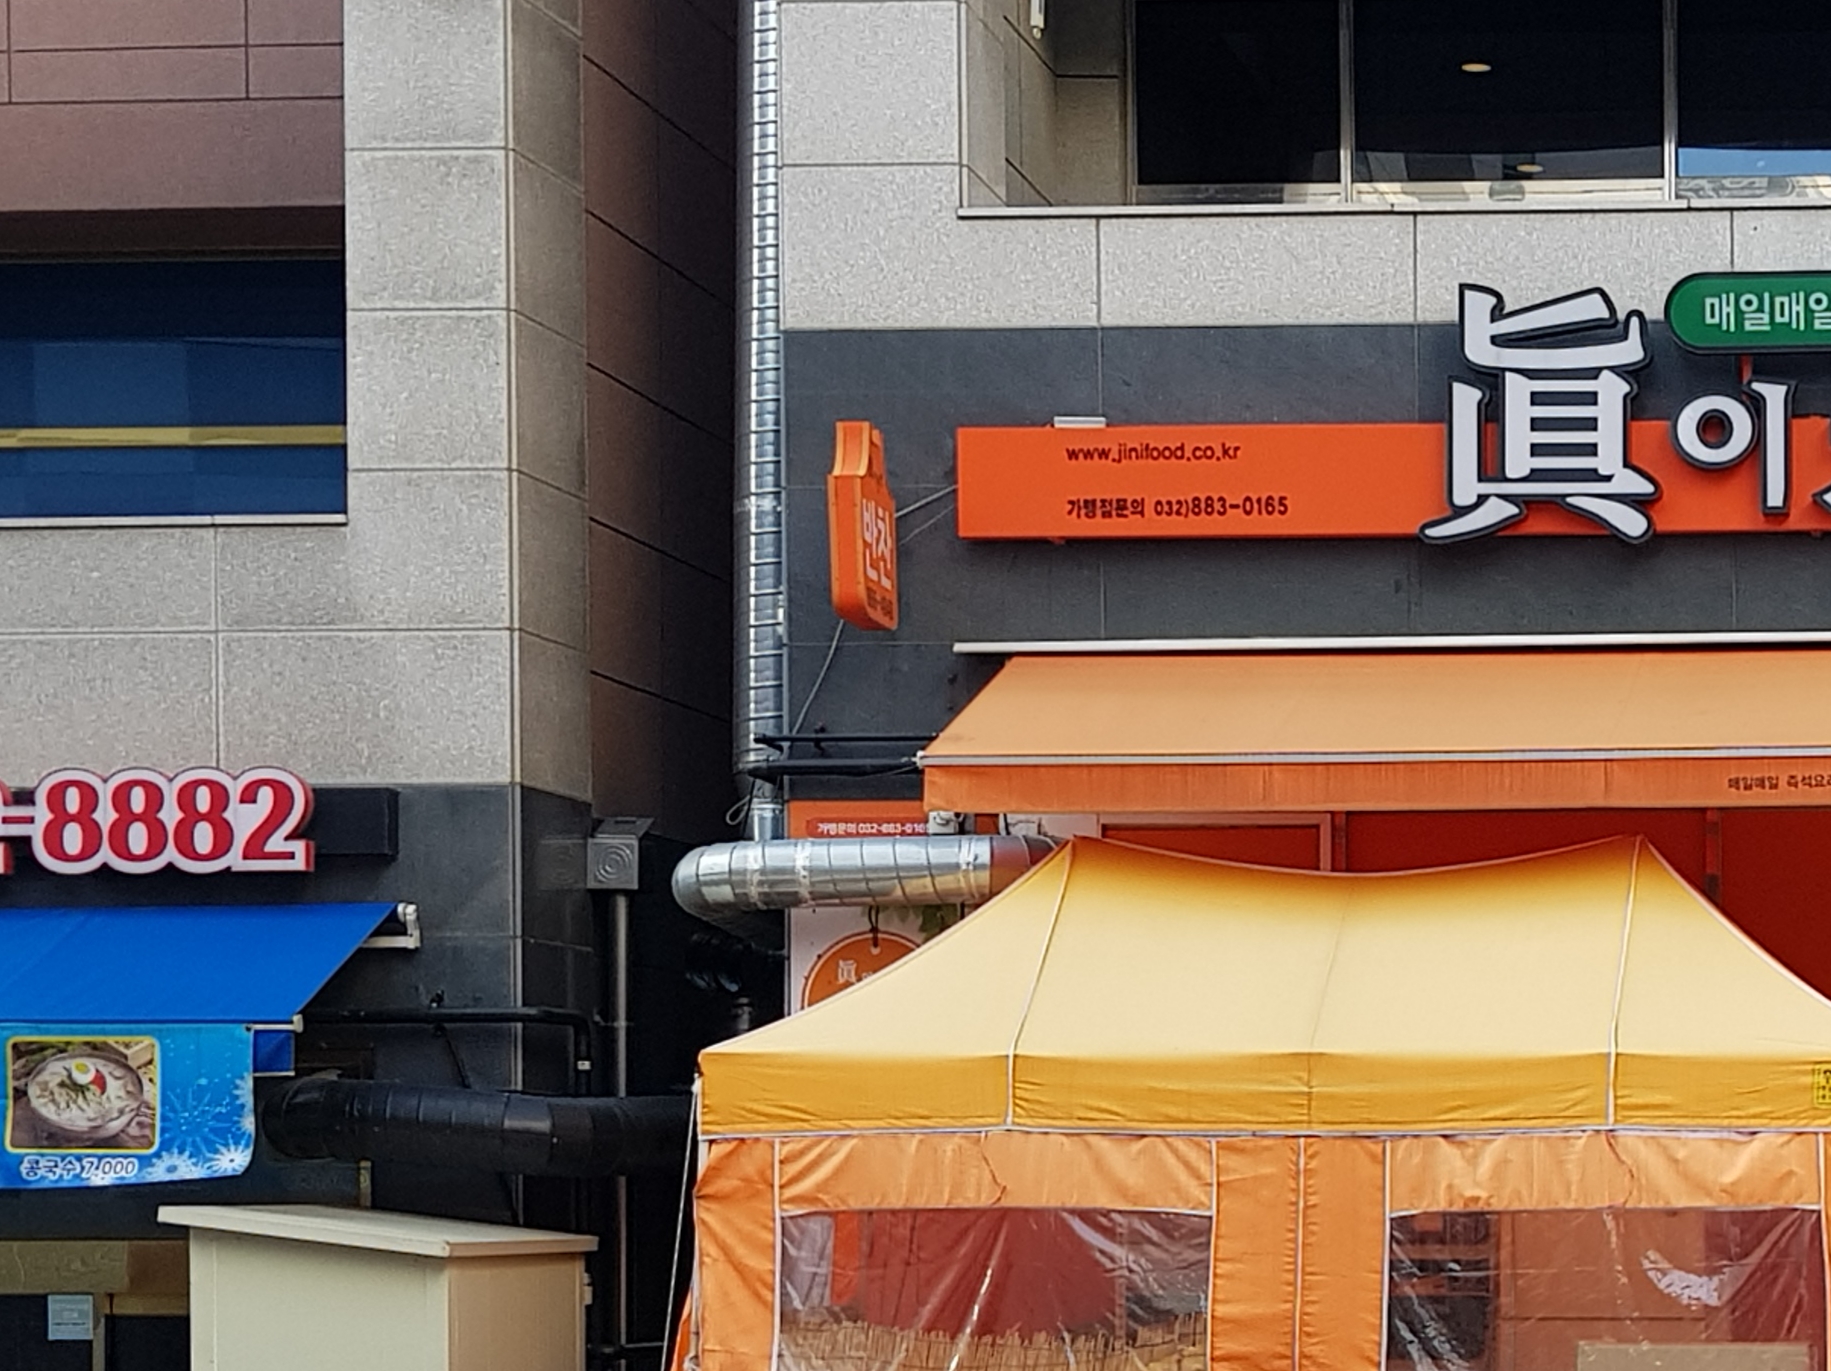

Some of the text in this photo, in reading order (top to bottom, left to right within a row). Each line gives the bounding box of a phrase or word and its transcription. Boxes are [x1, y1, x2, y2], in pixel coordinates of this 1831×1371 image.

[1066, 442, 1242, 464] www.jinifood.co.kr
[1153, 495, 1289, 519] 032)883-0165
[22, 1157, 79, 1179] 콩국수
